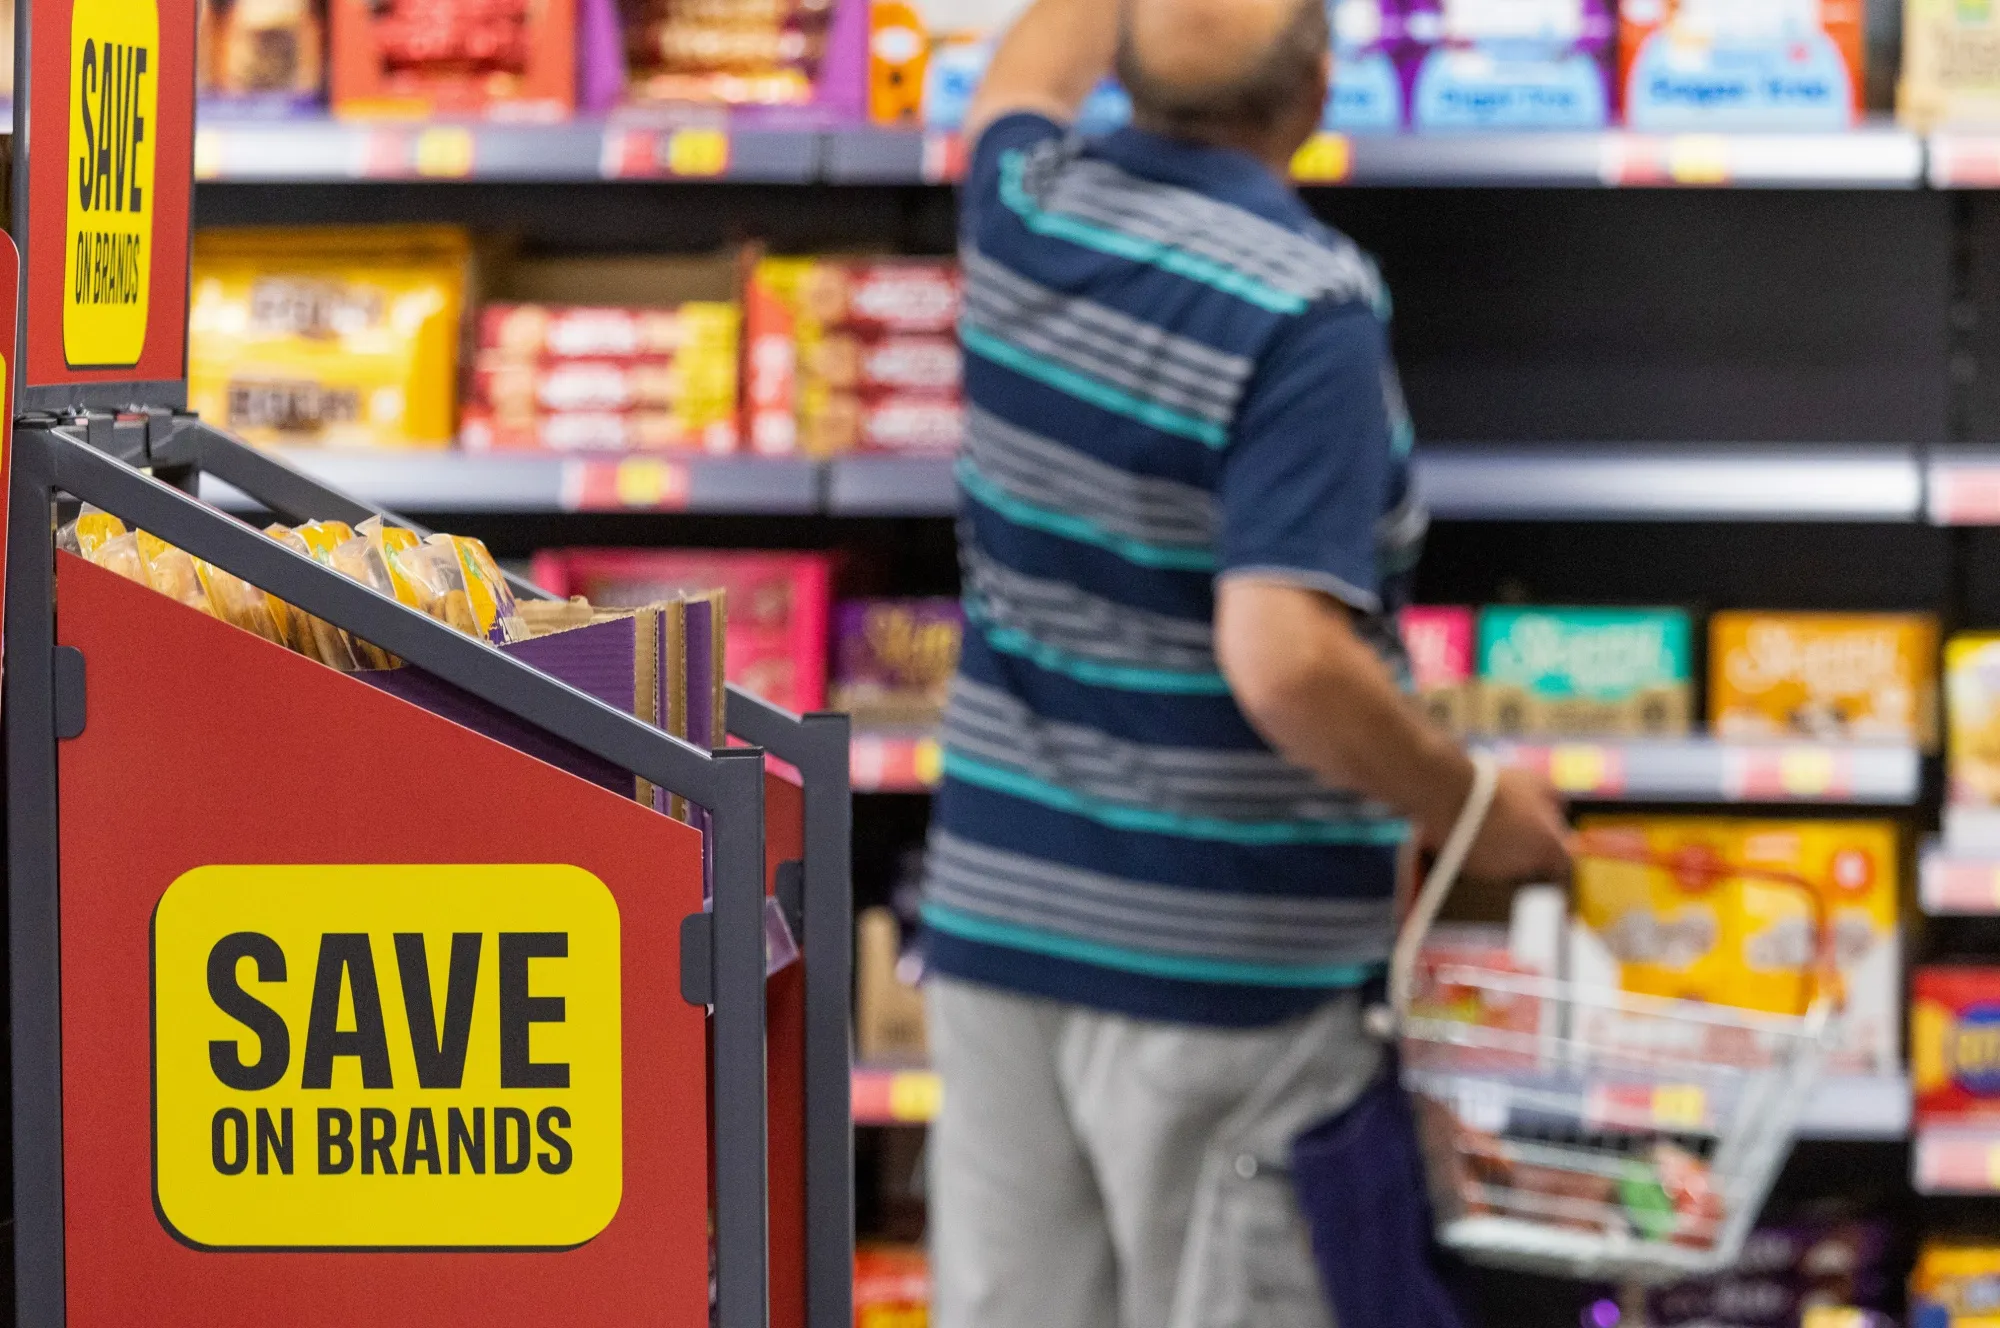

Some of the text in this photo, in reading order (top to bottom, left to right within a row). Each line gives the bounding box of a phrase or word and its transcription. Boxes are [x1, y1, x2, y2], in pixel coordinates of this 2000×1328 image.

[79, 38, 147, 213] SAVE
[75, 231, 140, 304] ON BRANDS
[206, 931, 571, 1092] SAVE
[211, 1106, 573, 1176] ON BRANDS
